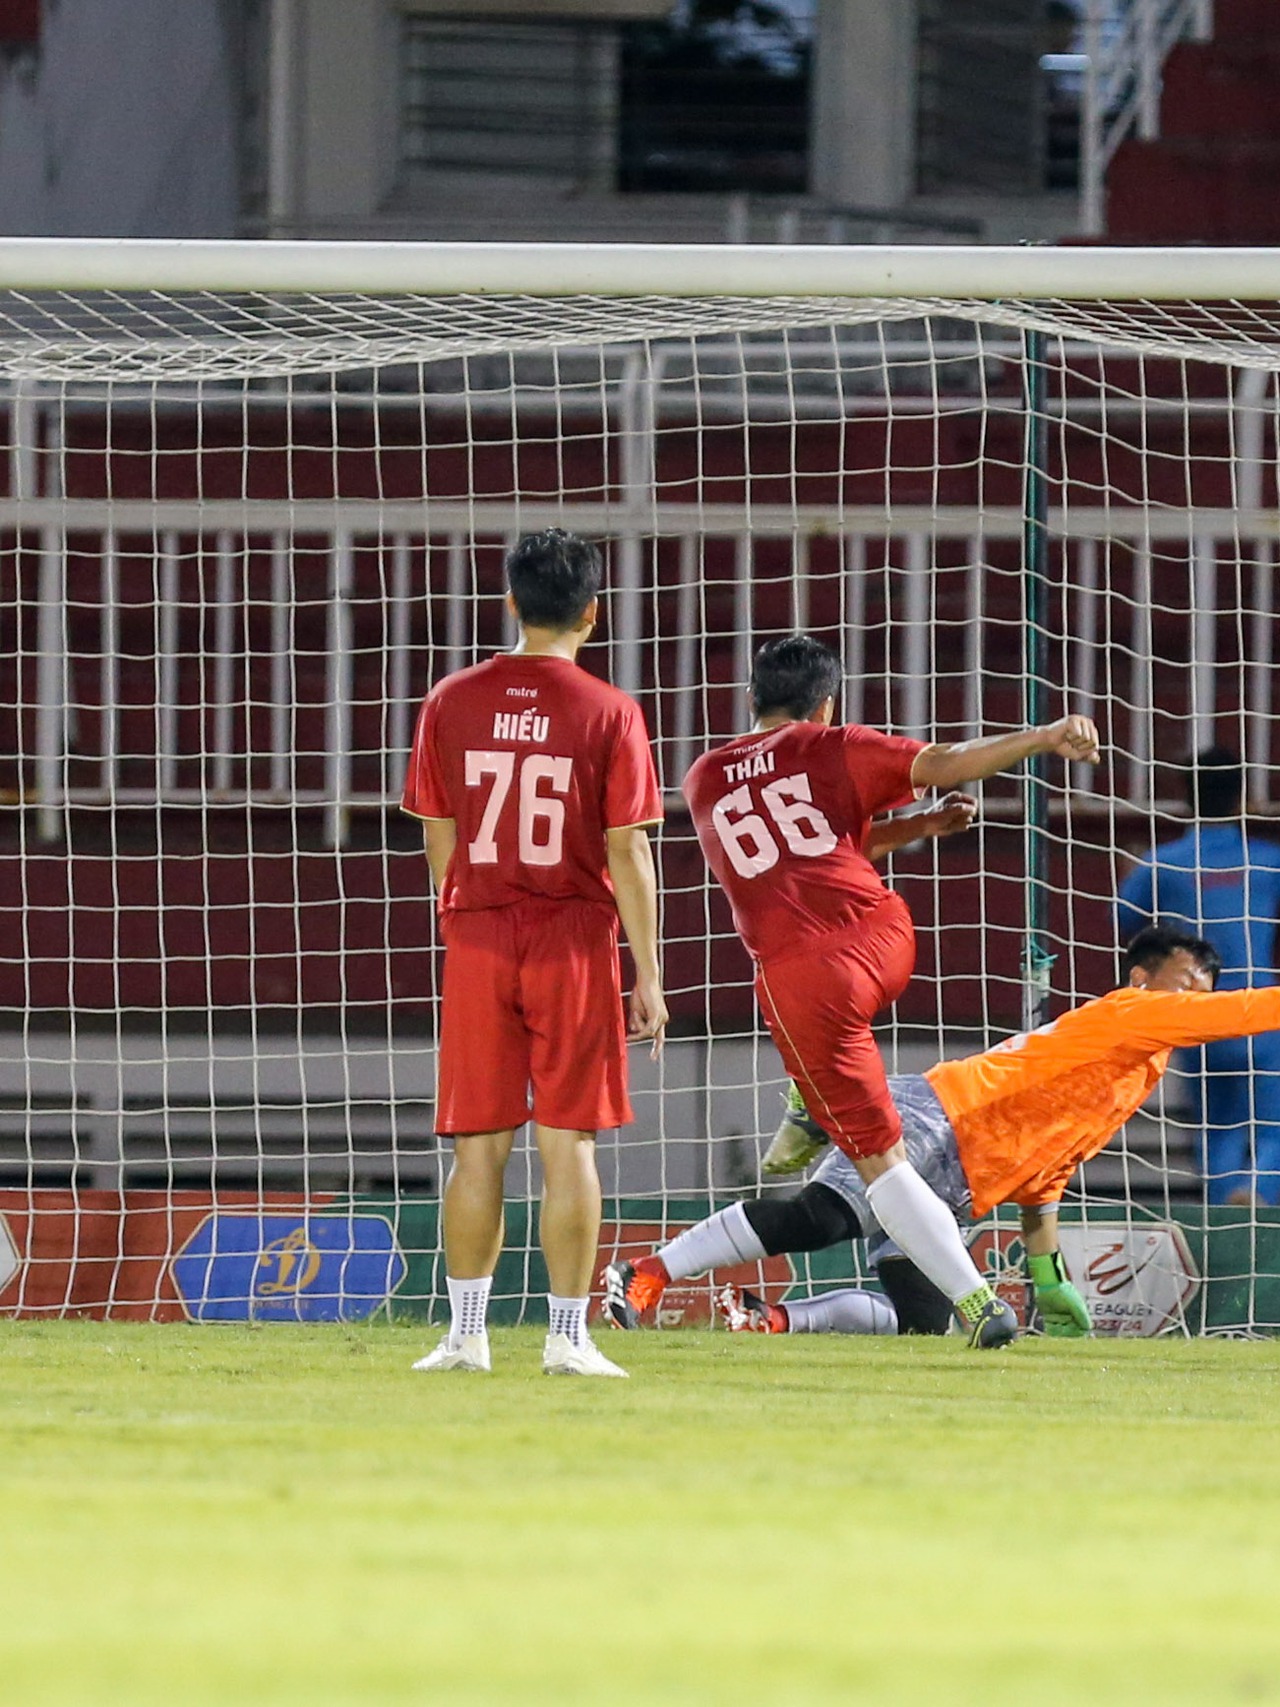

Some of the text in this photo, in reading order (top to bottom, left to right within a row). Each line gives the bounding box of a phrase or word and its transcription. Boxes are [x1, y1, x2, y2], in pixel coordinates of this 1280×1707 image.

[506, 687, 539, 698] mitre
[493, 706, 550, 743] HIẾU
[723, 750, 776, 783] THÁI
[464, 750, 574, 866] 76
[712, 772, 838, 879] 66
